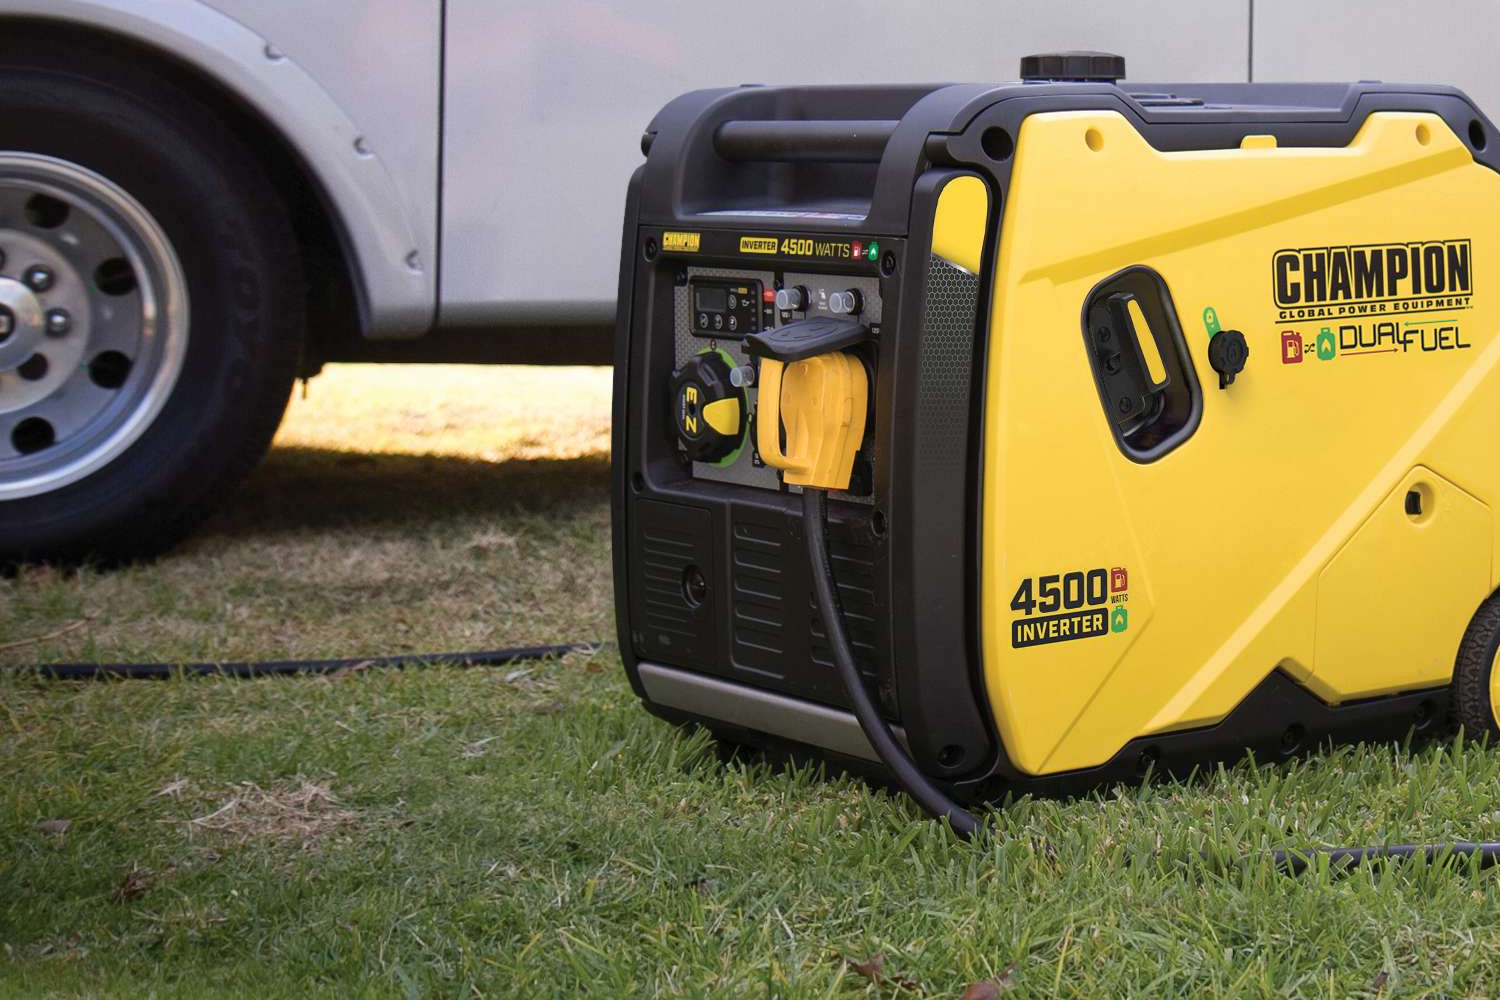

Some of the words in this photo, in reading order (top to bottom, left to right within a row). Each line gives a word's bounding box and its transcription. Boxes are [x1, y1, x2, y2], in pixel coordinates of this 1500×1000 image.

[742, 239, 776, 251] INVERTER
[781, 238, 814, 256] 4500
[815, 242, 850, 258] WATTS
[1275, 243, 1470, 305] CHAMPION
[1279, 307, 1334, 320] GLOBAL
[1338, 303, 1387, 316] POWER
[1393, 297, 1471, 311] EQUIPMENT
[1010, 568, 1108, 616] 4500
[1111, 593, 1129, 604] WATTS
[1017, 613, 1103, 643] INVERTER
